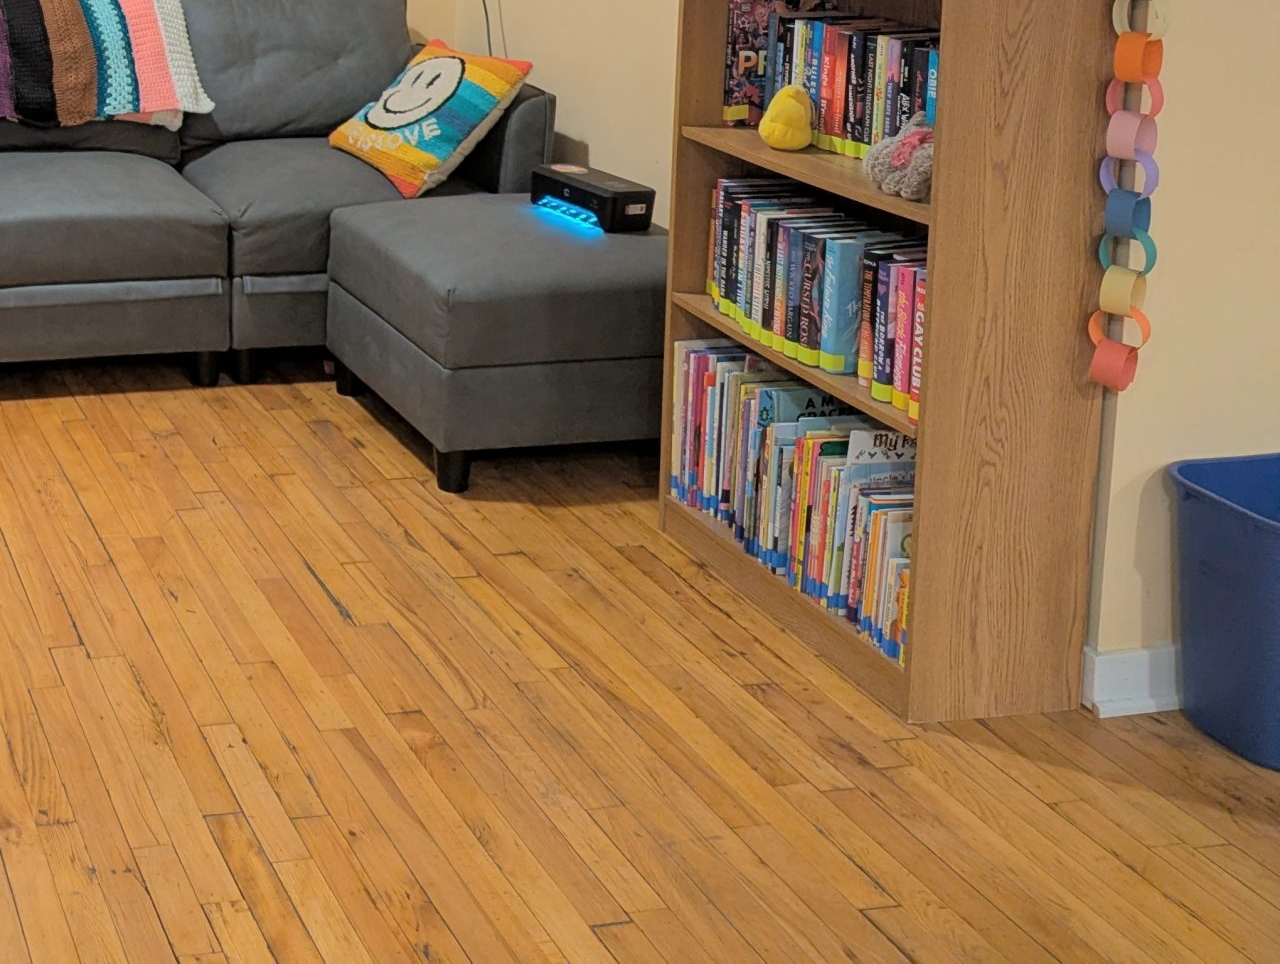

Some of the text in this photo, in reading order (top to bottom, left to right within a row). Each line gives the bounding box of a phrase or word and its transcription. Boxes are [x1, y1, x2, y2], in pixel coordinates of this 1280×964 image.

[928, 68, 937, 98] OBIE
[864, 94, 872, 126] TELEGRAPH
[802, 263, 812, 314] CURSED
[913, 312, 924, 346] GAY
[894, 339, 906, 390] Flamingo
[873, 432, 899, 451] My
